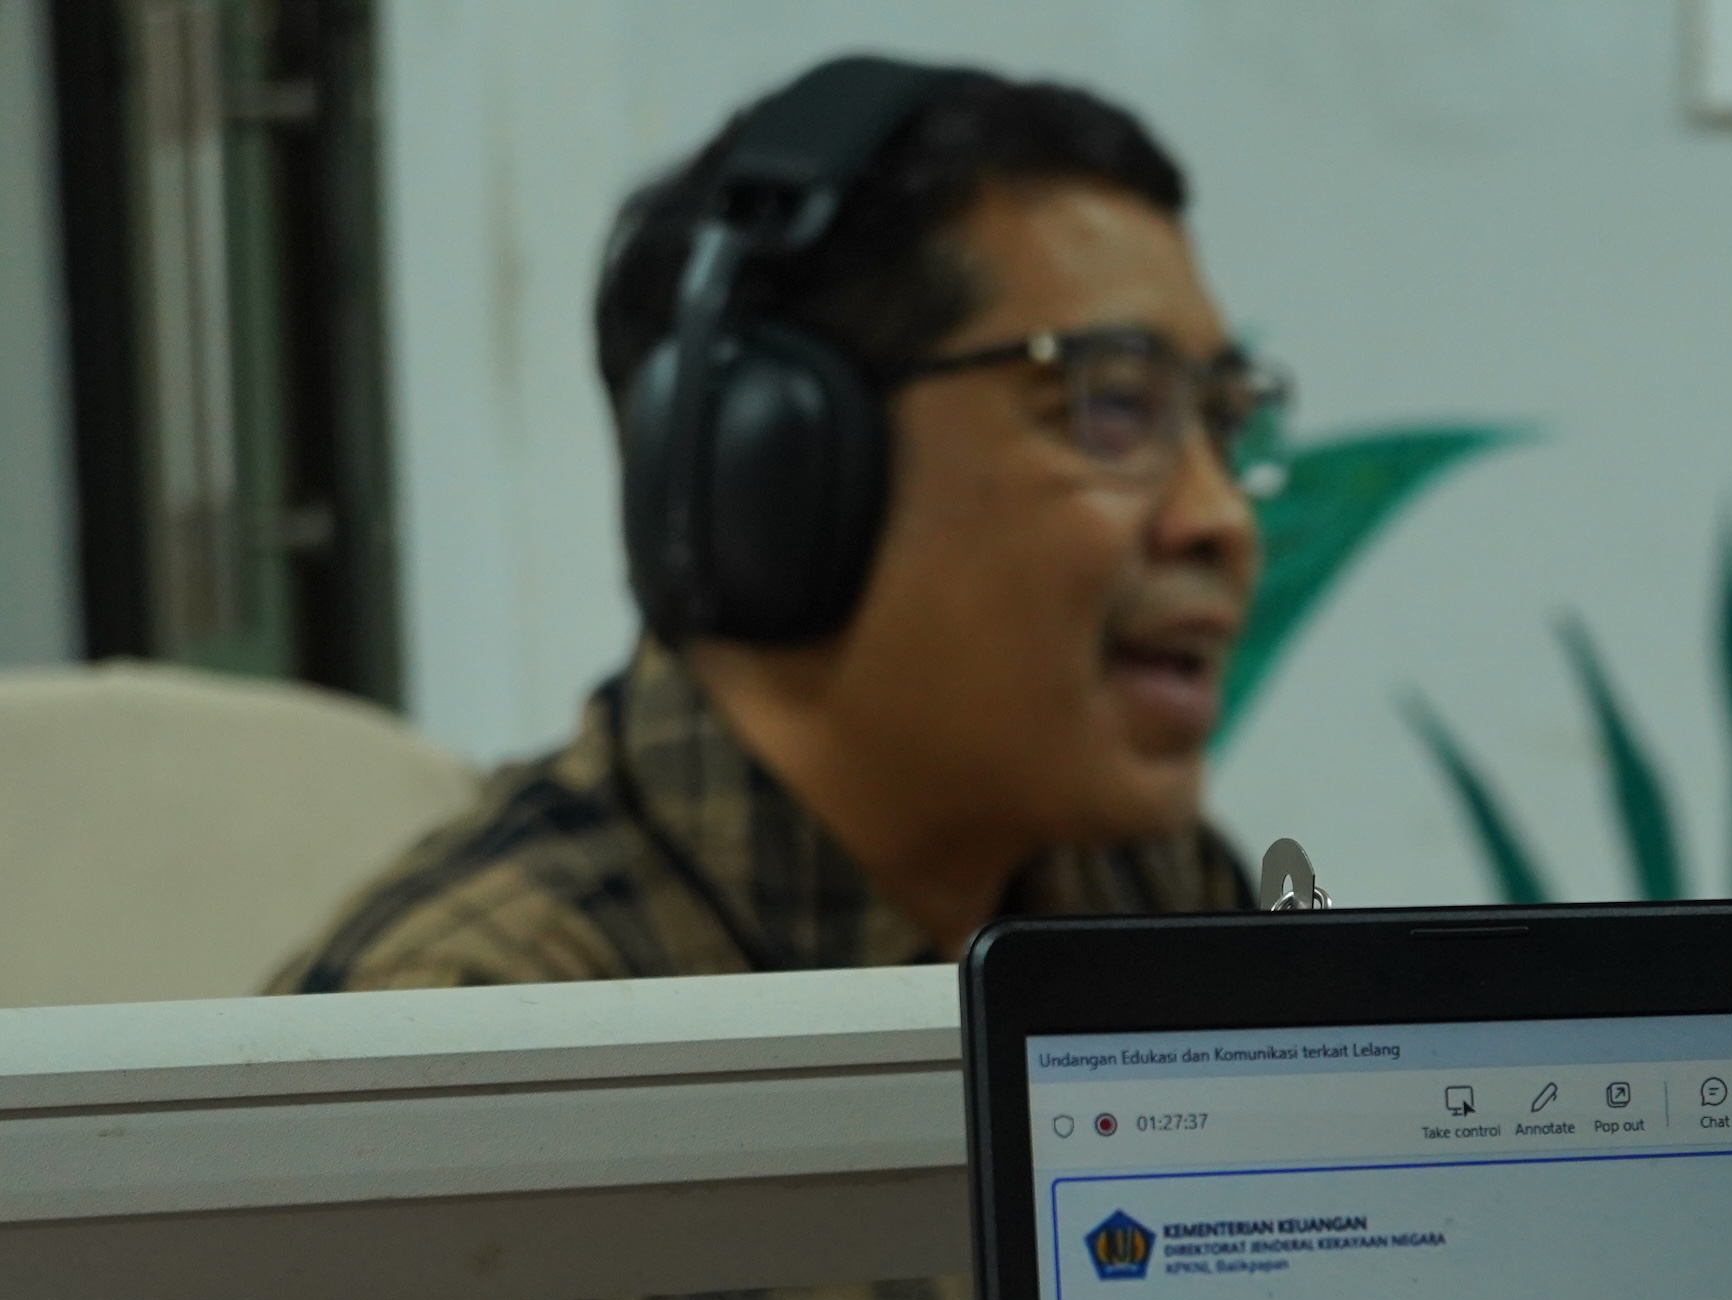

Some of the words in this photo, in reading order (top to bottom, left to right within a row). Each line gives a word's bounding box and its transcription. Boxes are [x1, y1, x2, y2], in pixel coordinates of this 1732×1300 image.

[1039, 1052, 1117, 1070] Undangan
[1122, 1049, 1178, 1065] Edukasi
[1182, 1048, 1210, 1063] dan
[1215, 1045, 1298, 1062] Komunikasi
[1303, 1044, 1349, 1060] terkait
[1353, 1043, 1401, 1060] Lelang
[1136, 1114, 1208, 1132] 01:27:37
[1515, 1122, 1576, 1136] Annotate
[1595, 1120, 1619, 1134] Pop
[1623, 1120, 1645, 1132] out
[1700, 1115, 1730, 1129] Chat
[1422, 1126, 1451, 1140] Take
[1455, 1124, 1501, 1138] control
[1163, 1221, 1274, 1239] KEMENTERIAN
[1278, 1217, 1367, 1234] KEUANGAN
[1164, 1241, 1247, 1257] DIREKTORAT
[1391, 1232, 1446, 1247] NEGARA
